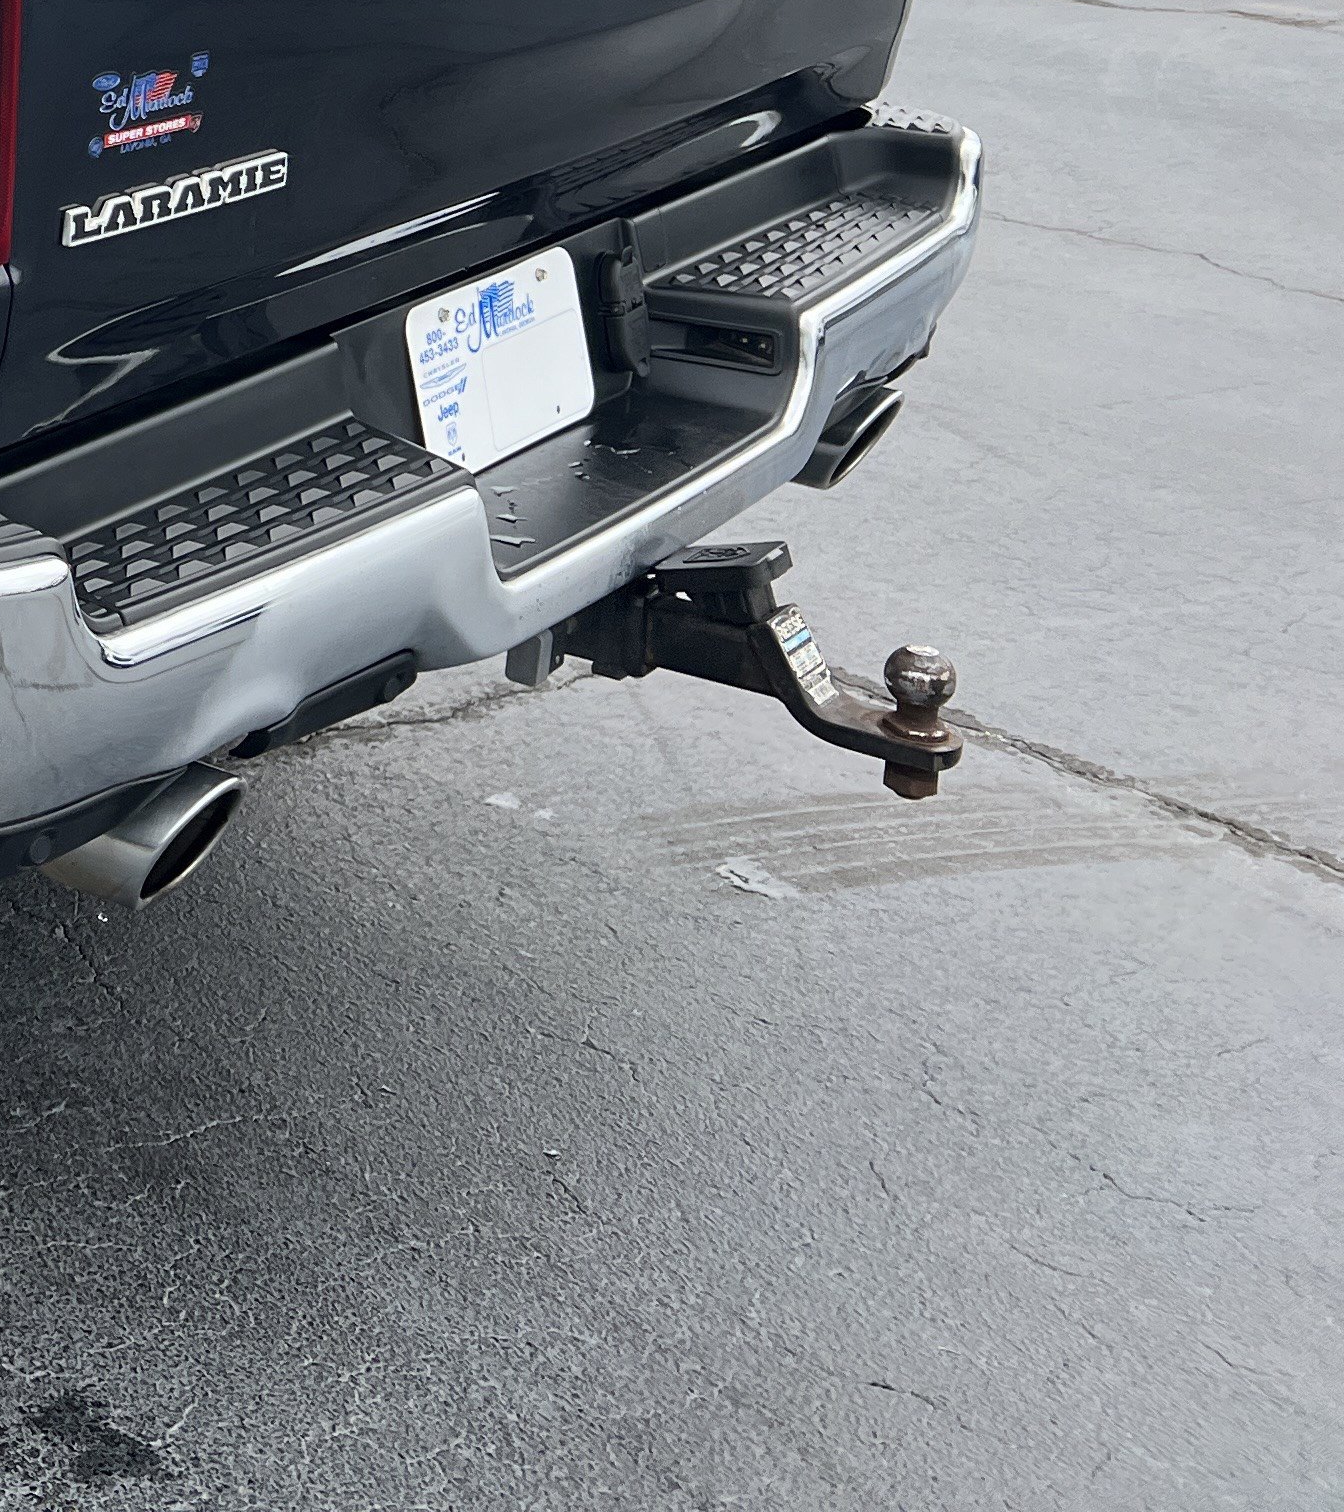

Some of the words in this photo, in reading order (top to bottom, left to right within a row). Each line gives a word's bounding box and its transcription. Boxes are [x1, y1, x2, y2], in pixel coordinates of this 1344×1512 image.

[99, 87, 129, 114] Ed
[107, 126, 144, 146] SUPER
[144, 116, 188, 137] STORES
[63, 151, 289, 248] LARAMIE
[454, 303, 477, 334] Ed
[438, 401, 459, 422] Jeep
